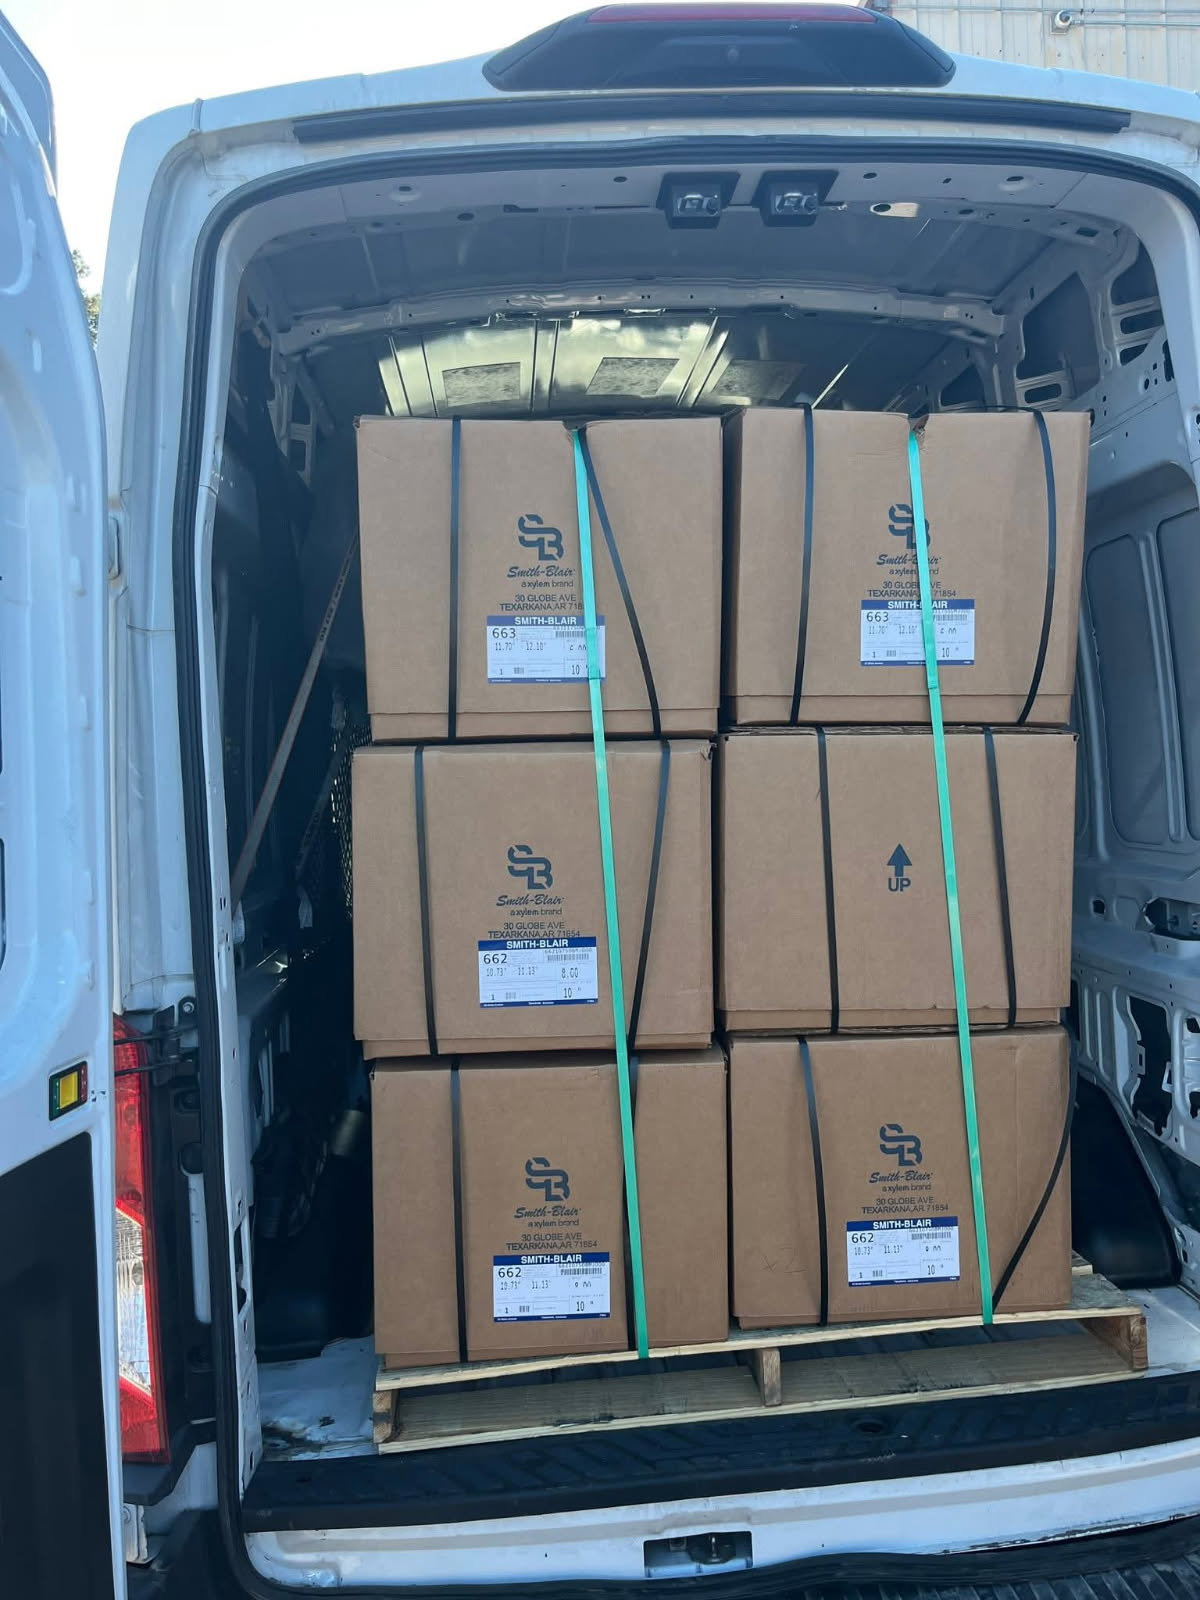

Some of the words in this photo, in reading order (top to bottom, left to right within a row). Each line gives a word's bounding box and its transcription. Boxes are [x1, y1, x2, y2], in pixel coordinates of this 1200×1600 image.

[507, 565, 574, 578] Smith-Blair
[528, 580, 550, 589] xylem
[882, 581, 892, 589] 30
[558, 594, 577, 602] AVE
[514, 616, 577, 626] SMITH-BLAIR
[866, 611, 890, 622] 663
[492, 627, 516, 638] 663
[888, 878, 912, 892] UP
[496, 894, 564, 906] Smith-Blair
[516, 908, 540, 918] xylem
[540, 907, 562, 916] brand
[504, 922, 514, 930] 30
[516, 922, 546, 930] GLOBE
[547, 921, 565, 930] AVE
[506, 939, 569, 950] SMITH-BLAIR
[484, 954, 508, 964] 662
[868, 1170, 932, 1184] Smith-Blair
[888, 1184, 910, 1193] xylem
[876, 1198, 886, 1206] 30
[888, 1197, 916, 1206] GLOBE
[918, 1196, 935, 1204] AVE
[514, 1206, 580, 1218] Smith-Blair
[534, 1220, 556, 1228] xylem
[558, 1218, 580, 1226] brand
[872, 1218, 932, 1230] SMITH-BLAIR
[522, 1234, 532, 1242] 30
[534, 1232, 563, 1242] GLOBE
[565, 1232, 582, 1240] AVE
[852, 1232, 874, 1244] 662
[520, 1254, 582, 1264] SMITH-BLAIR
[498, 1266, 522, 1278] 662
